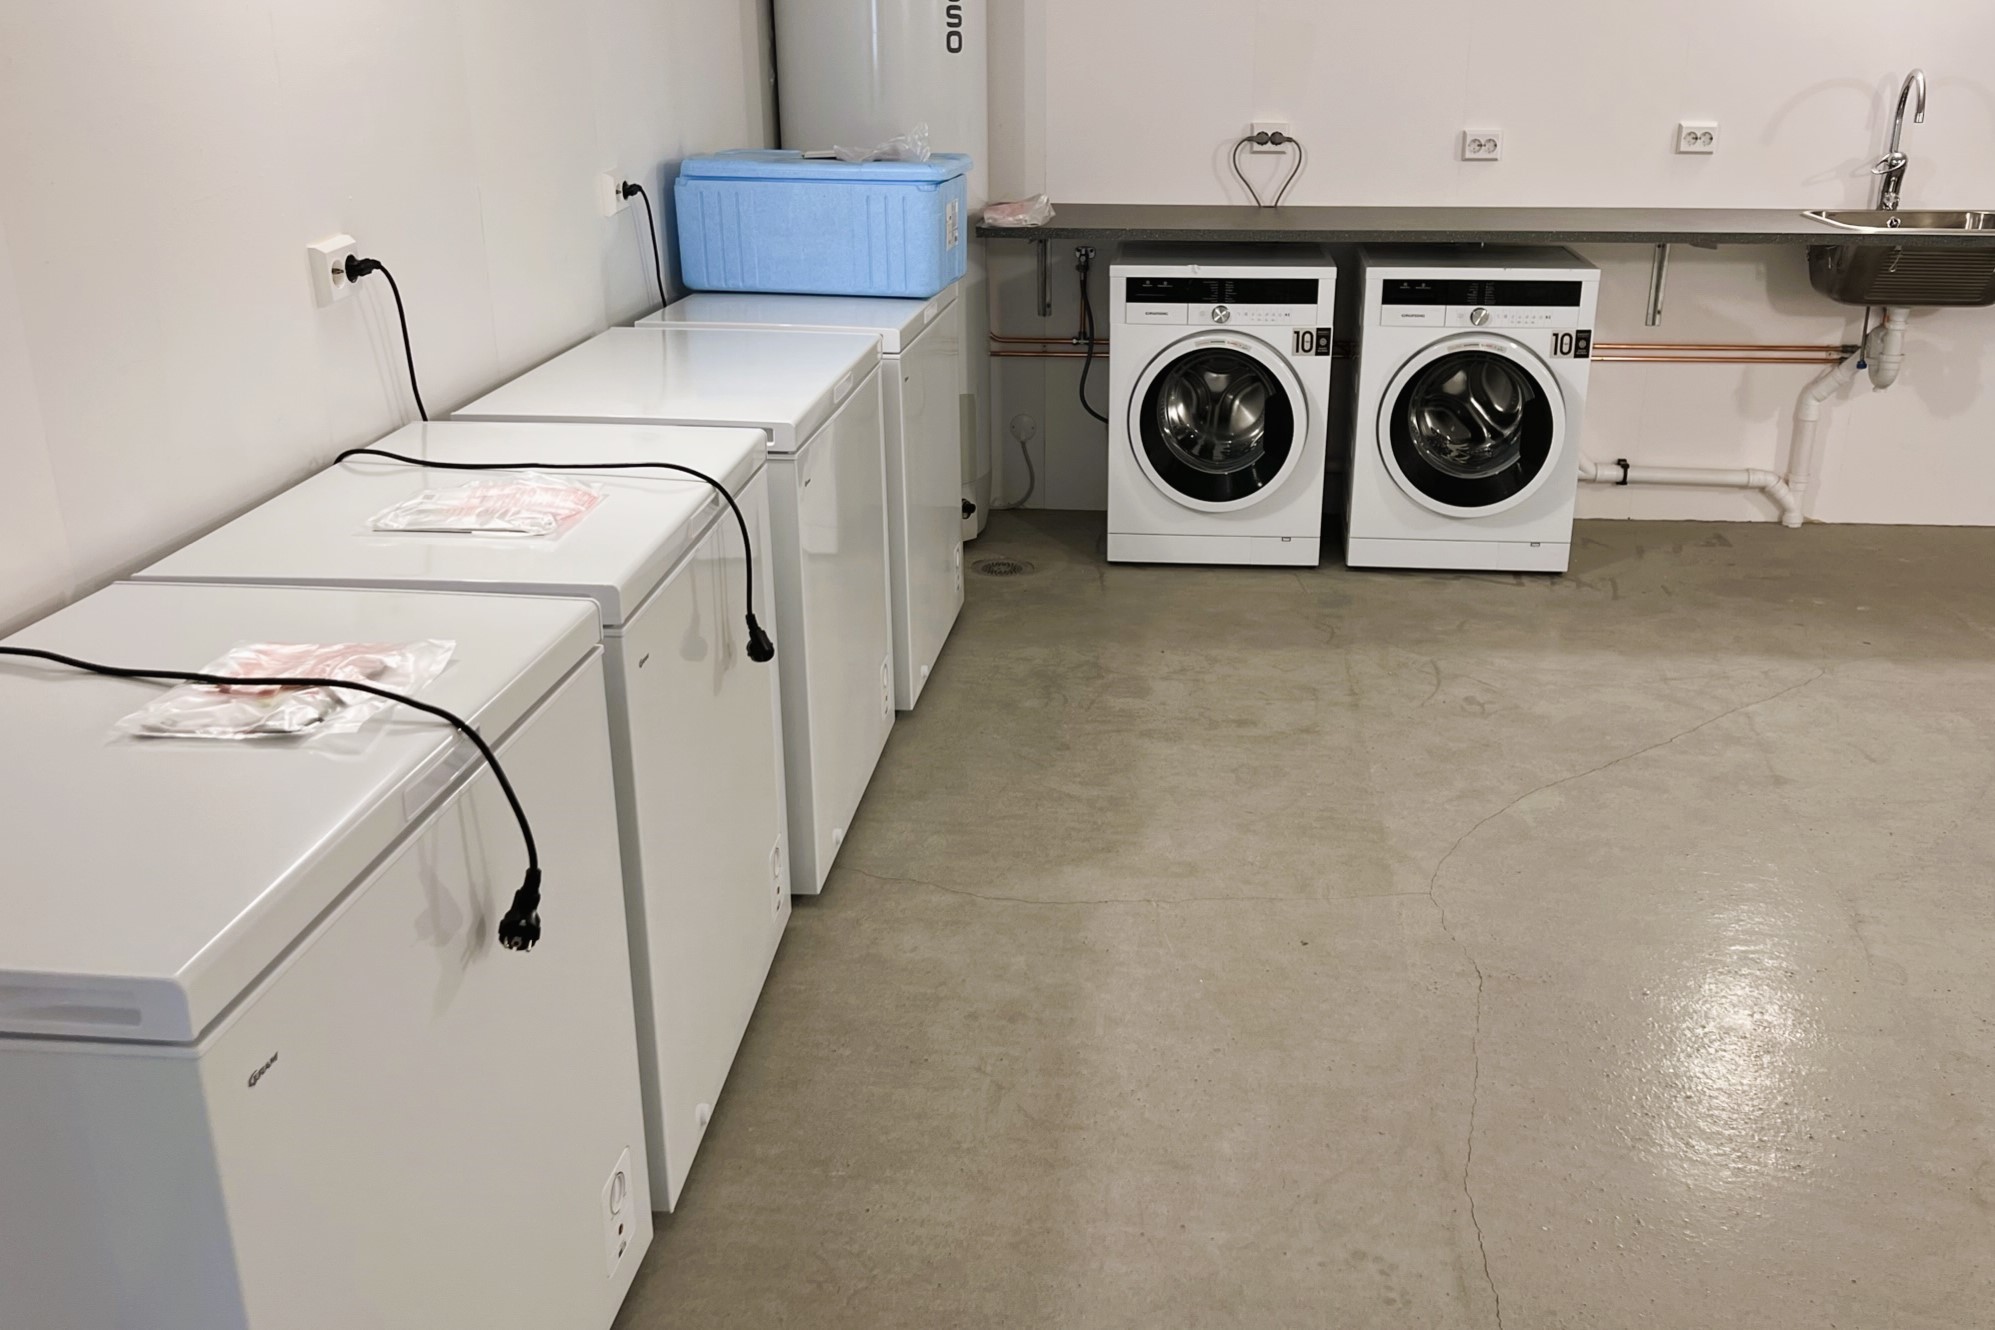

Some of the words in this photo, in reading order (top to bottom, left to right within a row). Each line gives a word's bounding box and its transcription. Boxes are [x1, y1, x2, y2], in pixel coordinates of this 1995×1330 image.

[946, 0, 963, 54] SO
[1293, 330, 1314, 353] 10
[1552, 332, 1574, 356] 10
